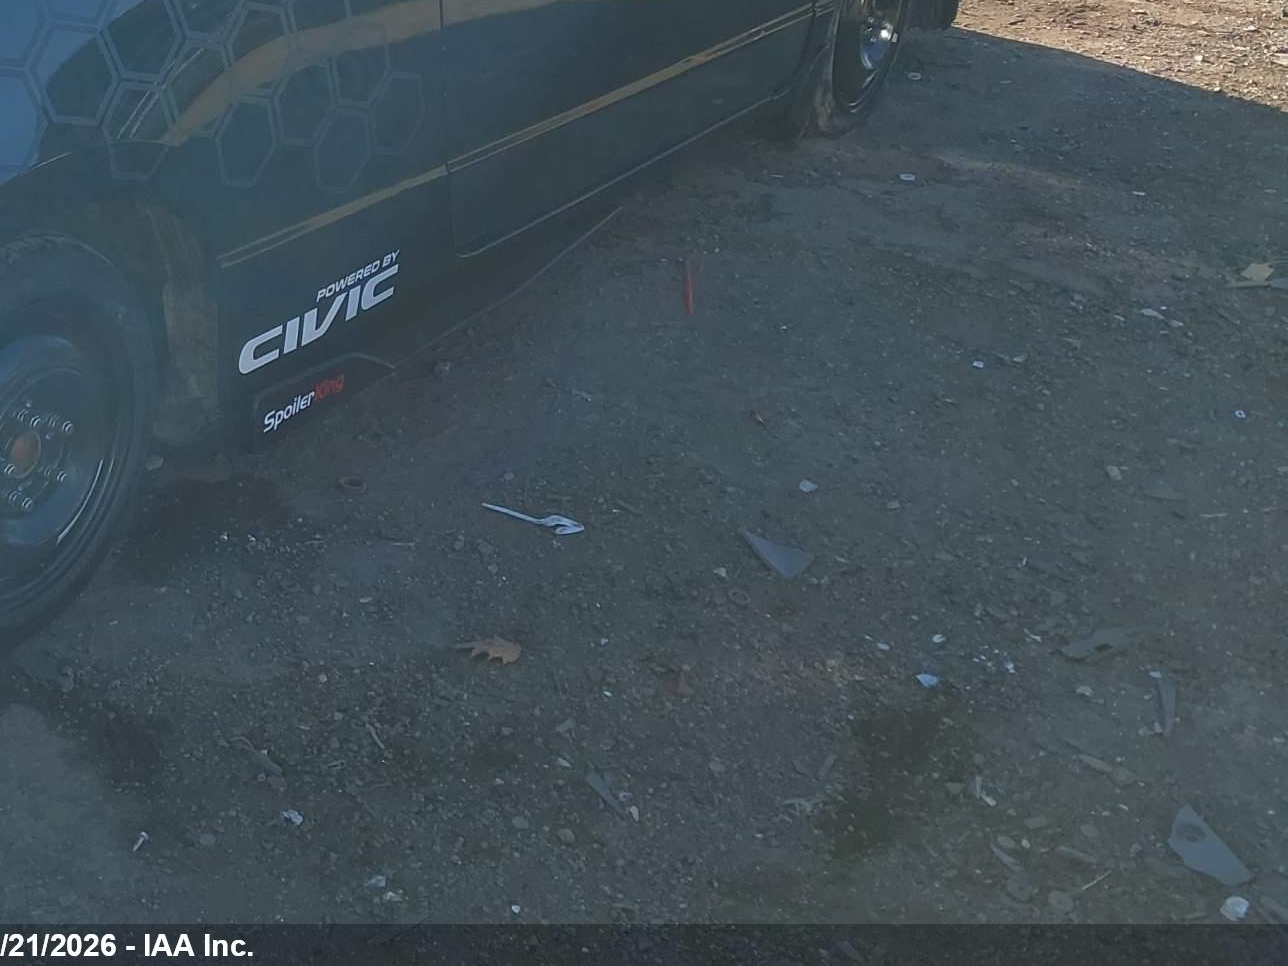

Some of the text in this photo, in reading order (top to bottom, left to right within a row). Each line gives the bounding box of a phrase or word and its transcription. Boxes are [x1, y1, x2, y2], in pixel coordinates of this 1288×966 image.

[316, 249, 400, 302] POWERED BY
[238, 263, 399, 375] CIVIC
